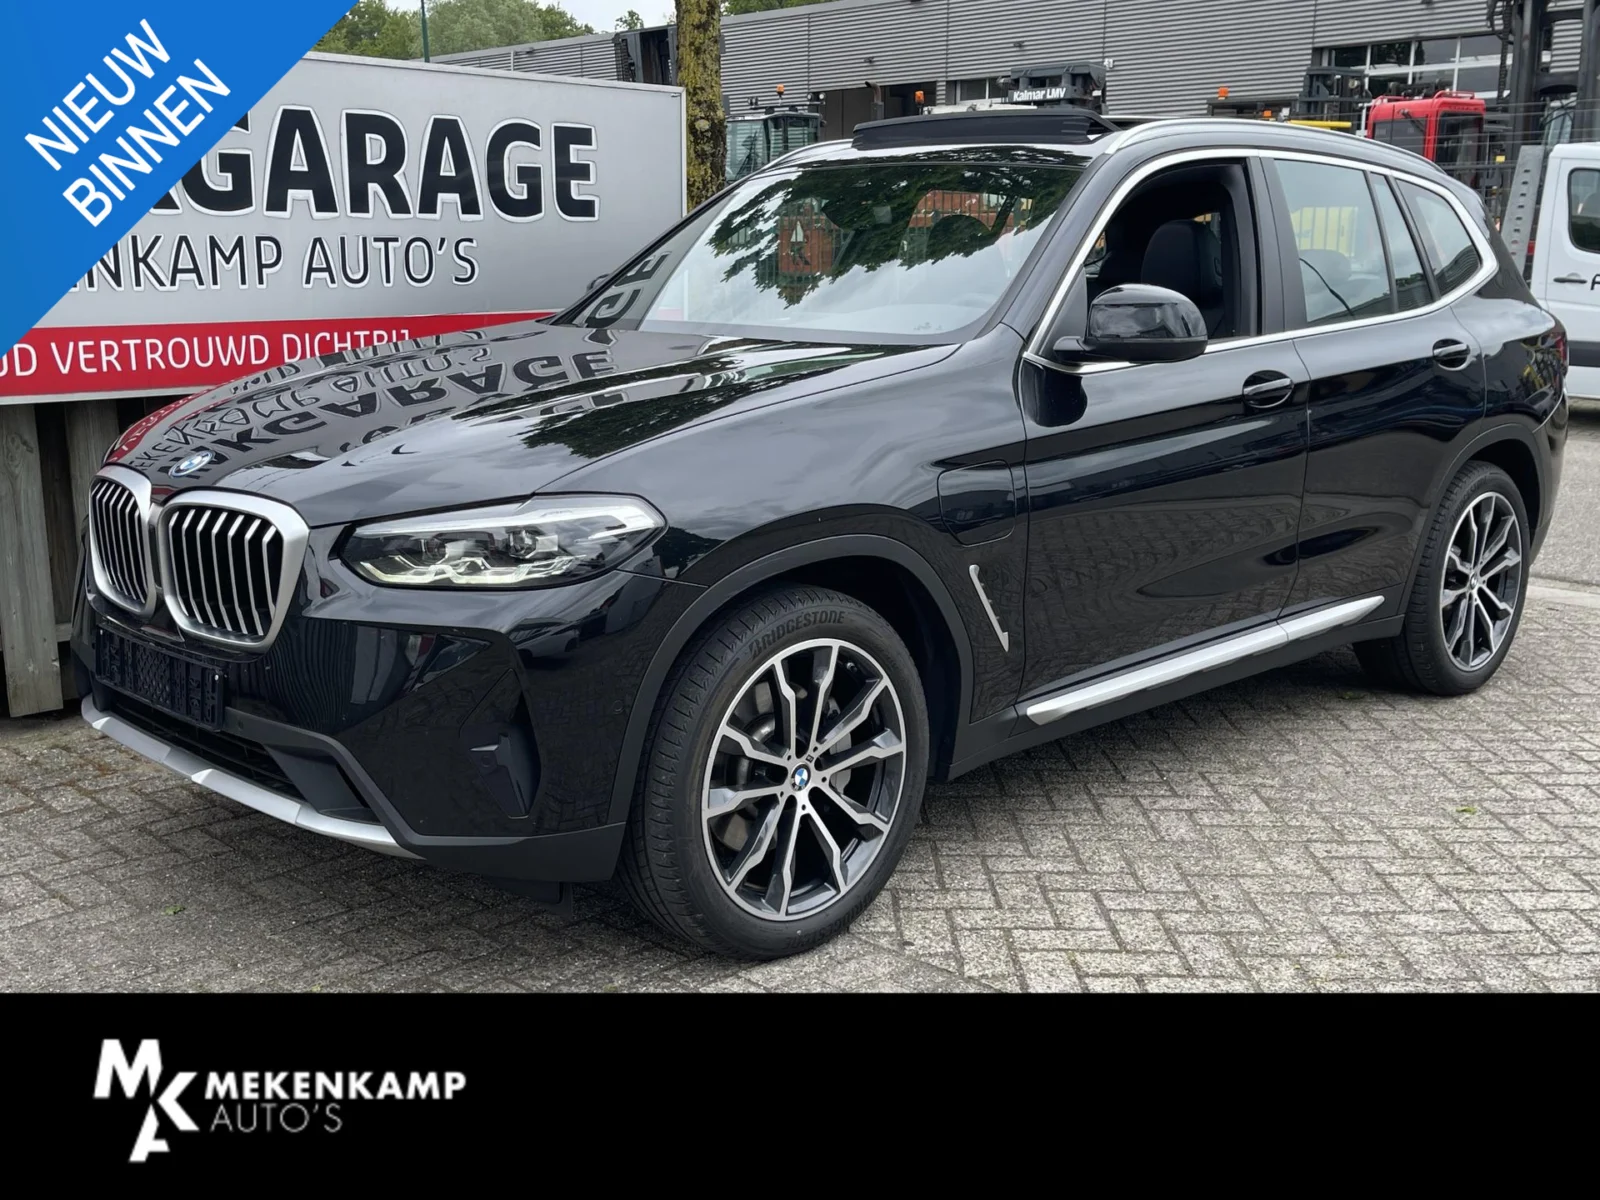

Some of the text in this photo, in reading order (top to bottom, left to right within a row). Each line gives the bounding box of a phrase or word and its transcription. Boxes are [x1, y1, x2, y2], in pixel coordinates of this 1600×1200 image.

[1013, 87, 1067, 102] Kalmar LMV
[151, 105, 599, 220] GARAGE
[70, 234, 479, 291] NKAMP AUTO'S
[50, 334, 270, 375] VERTROUWD
[747, 609, 846, 660] BRIDGESTONE
